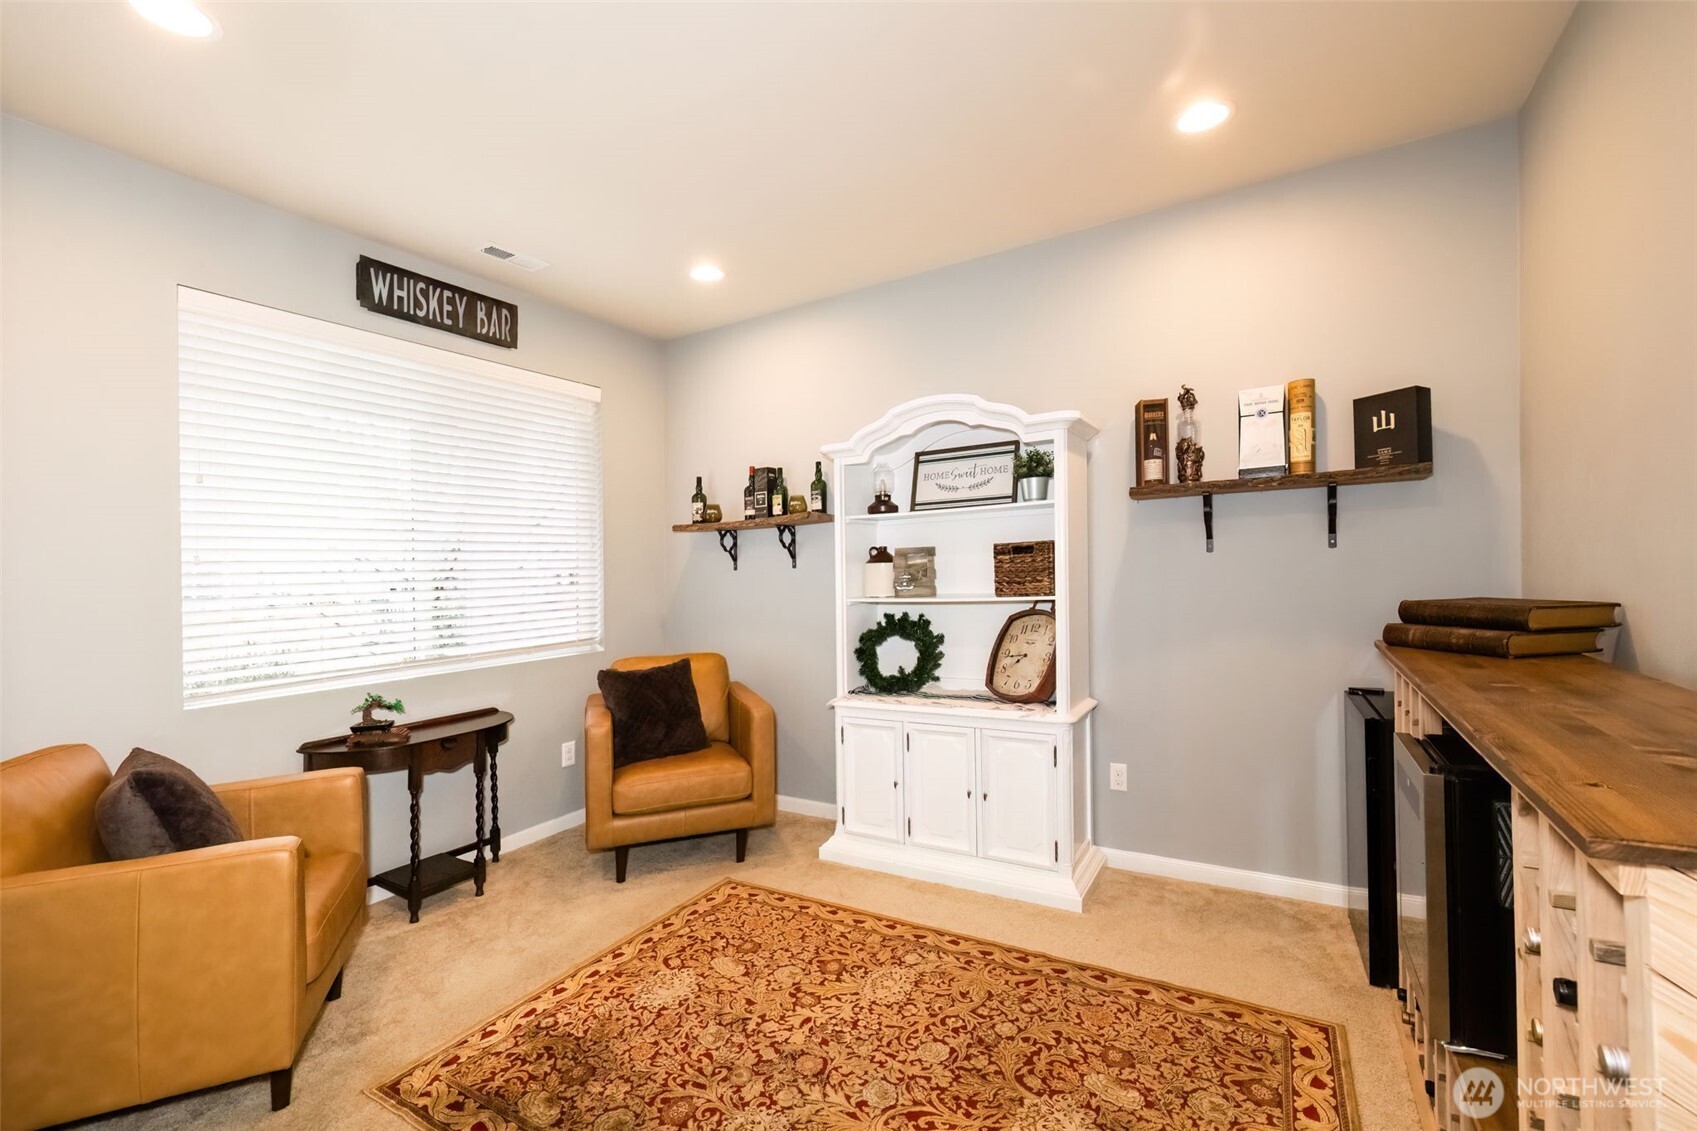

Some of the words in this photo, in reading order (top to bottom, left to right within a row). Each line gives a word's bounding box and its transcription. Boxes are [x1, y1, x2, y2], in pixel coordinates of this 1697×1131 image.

[370, 267, 467, 328] WHISKEY
[477, 300, 511, 342] BAR
[1372, 410, 1395, 433] 山
[923, 471, 950, 481] HOME
[950, 463, 978, 482] Sweet
[980, 464, 1009, 475] HOME
[1020, 624, 1029, 634] 11
[1030, 623, 1041, 633] 12
[1009, 634, 1018, 644] 10
[1004, 648, 1011, 658] 9
[1045, 652, 1052, 663] 3
[1000, 663, 1008, 673] 8
[1013, 680, 1020, 689] 6
[1024, 679, 1032, 689] 5
